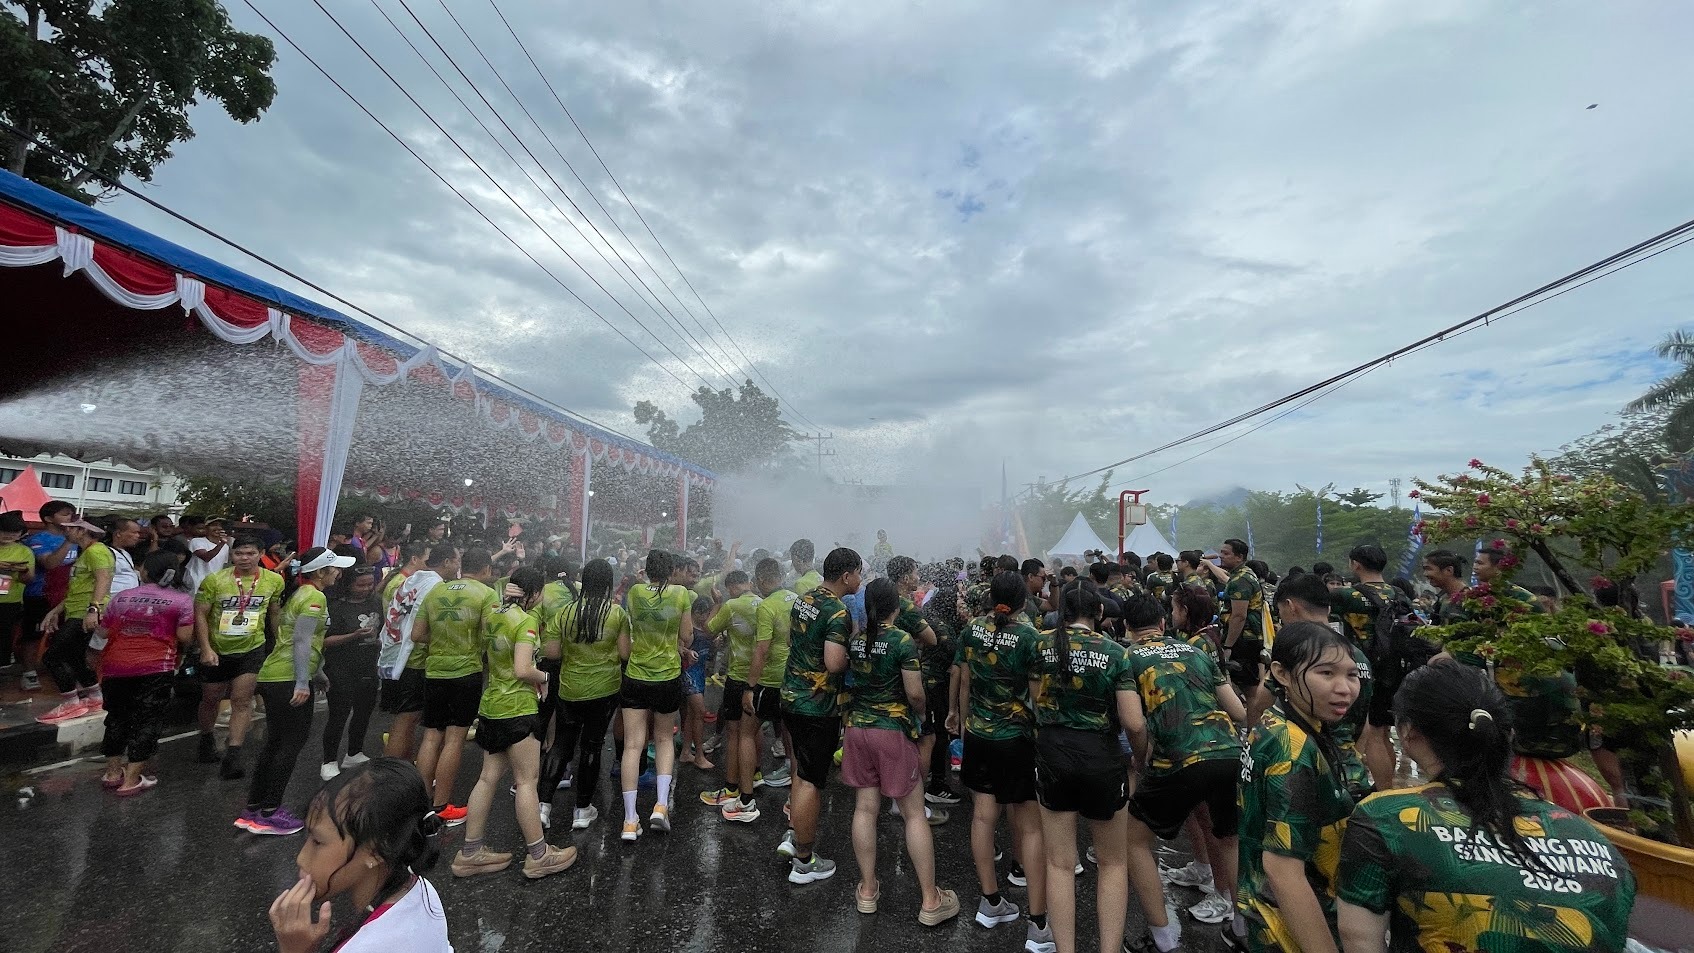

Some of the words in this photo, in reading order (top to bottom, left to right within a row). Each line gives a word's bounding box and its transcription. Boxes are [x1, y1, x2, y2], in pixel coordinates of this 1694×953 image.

[151, 598, 172, 606] ZERO
[972, 624, 985, 633] BAK
[1002, 632, 1020, 642] RUN
[875, 641, 888, 649] RUN
[1133, 646, 1151, 655] BAK
[1089, 650, 1109, 663] RUN
[1567, 839, 1612, 861] RUN
